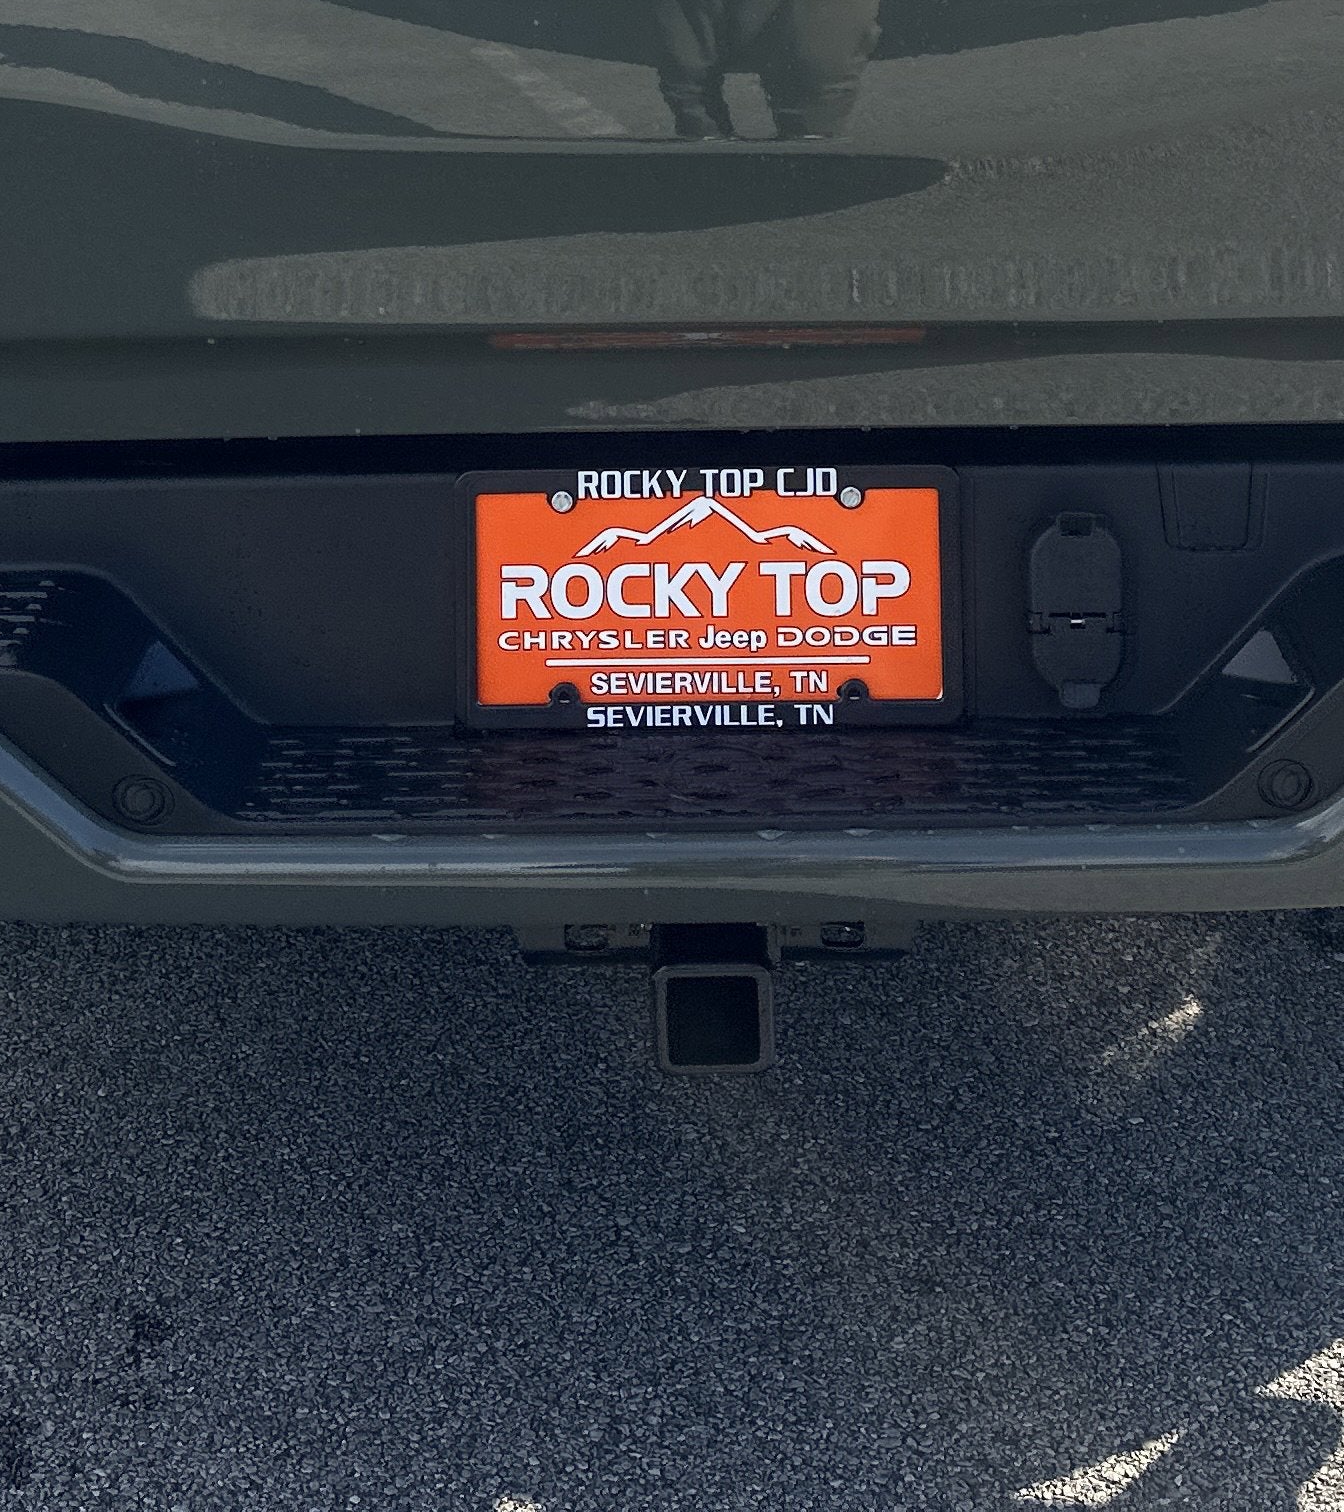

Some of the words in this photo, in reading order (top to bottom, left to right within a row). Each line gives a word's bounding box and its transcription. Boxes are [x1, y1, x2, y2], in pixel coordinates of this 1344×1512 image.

[577, 469, 688, 500] ROCKY
[699, 468, 764, 498] TOP
[776, 467, 837, 498] CJD
[500, 561, 747, 620] ROCKY
[759, 560, 911, 617] TOP
[498, 628, 690, 651] CHRYSLER
[698, 624, 767, 652] Jeep
[776, 625, 918, 648] DODGE
[590, 671, 780, 697] SEVIERVILLE,
[790, 670, 829, 694] TN
[586, 703, 784, 728] SEVIERVILLE,
[794, 703, 835, 725] TN
